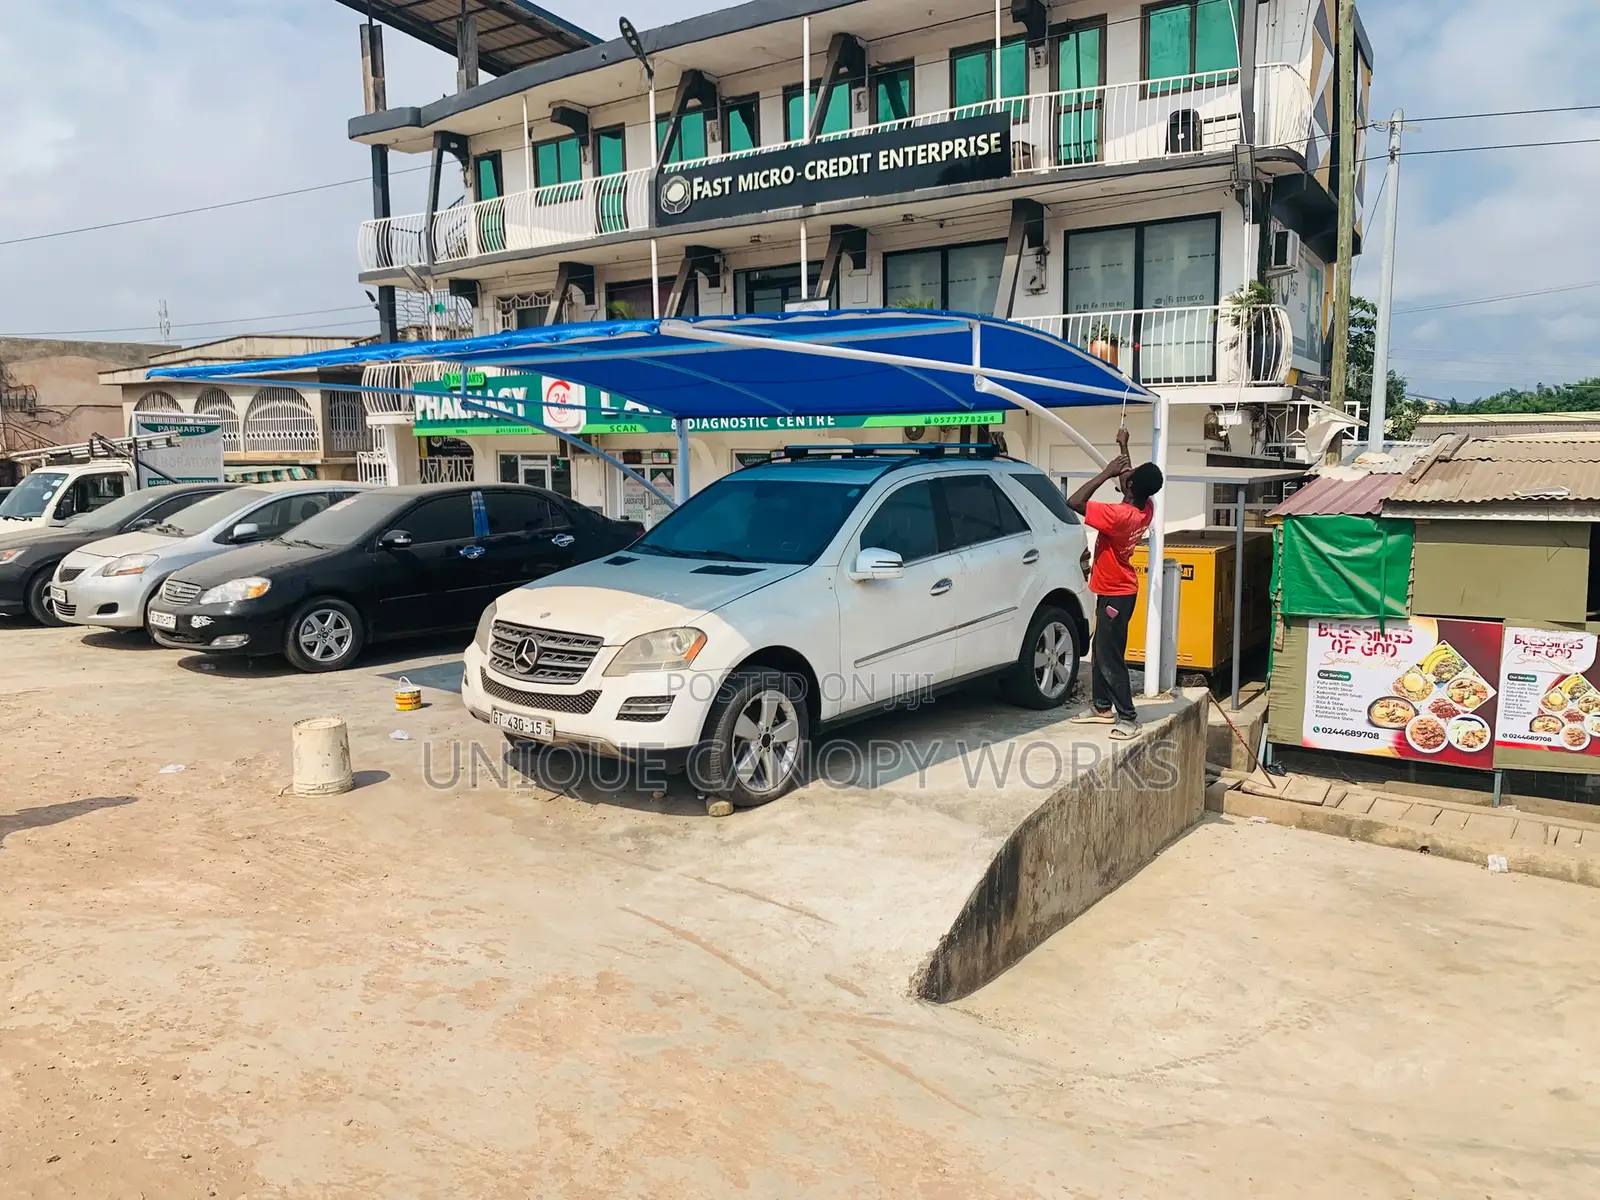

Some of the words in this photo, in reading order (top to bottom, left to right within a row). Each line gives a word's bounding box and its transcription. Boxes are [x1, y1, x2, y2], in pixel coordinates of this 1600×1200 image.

[692, 176, 732, 200] FAST
[877, 132, 1002, 171] ENTERPRISE
[687, 417, 769, 430] DIAGNOSTIC
[776, 416, 836, 428] CENTRE
[933, 415, 995, 424] 0577778284
[610, 424, 637, 433] SCAN
[1180, 567, 1193, 578] AT
[1331, 639, 1355, 654] OF
[1361, 642, 1397, 657] GOD
[493, 711, 503, 725] GT
[1321, 727, 1380, 740] 0244689708
[1509, 733, 1552, 742] 0244689708
